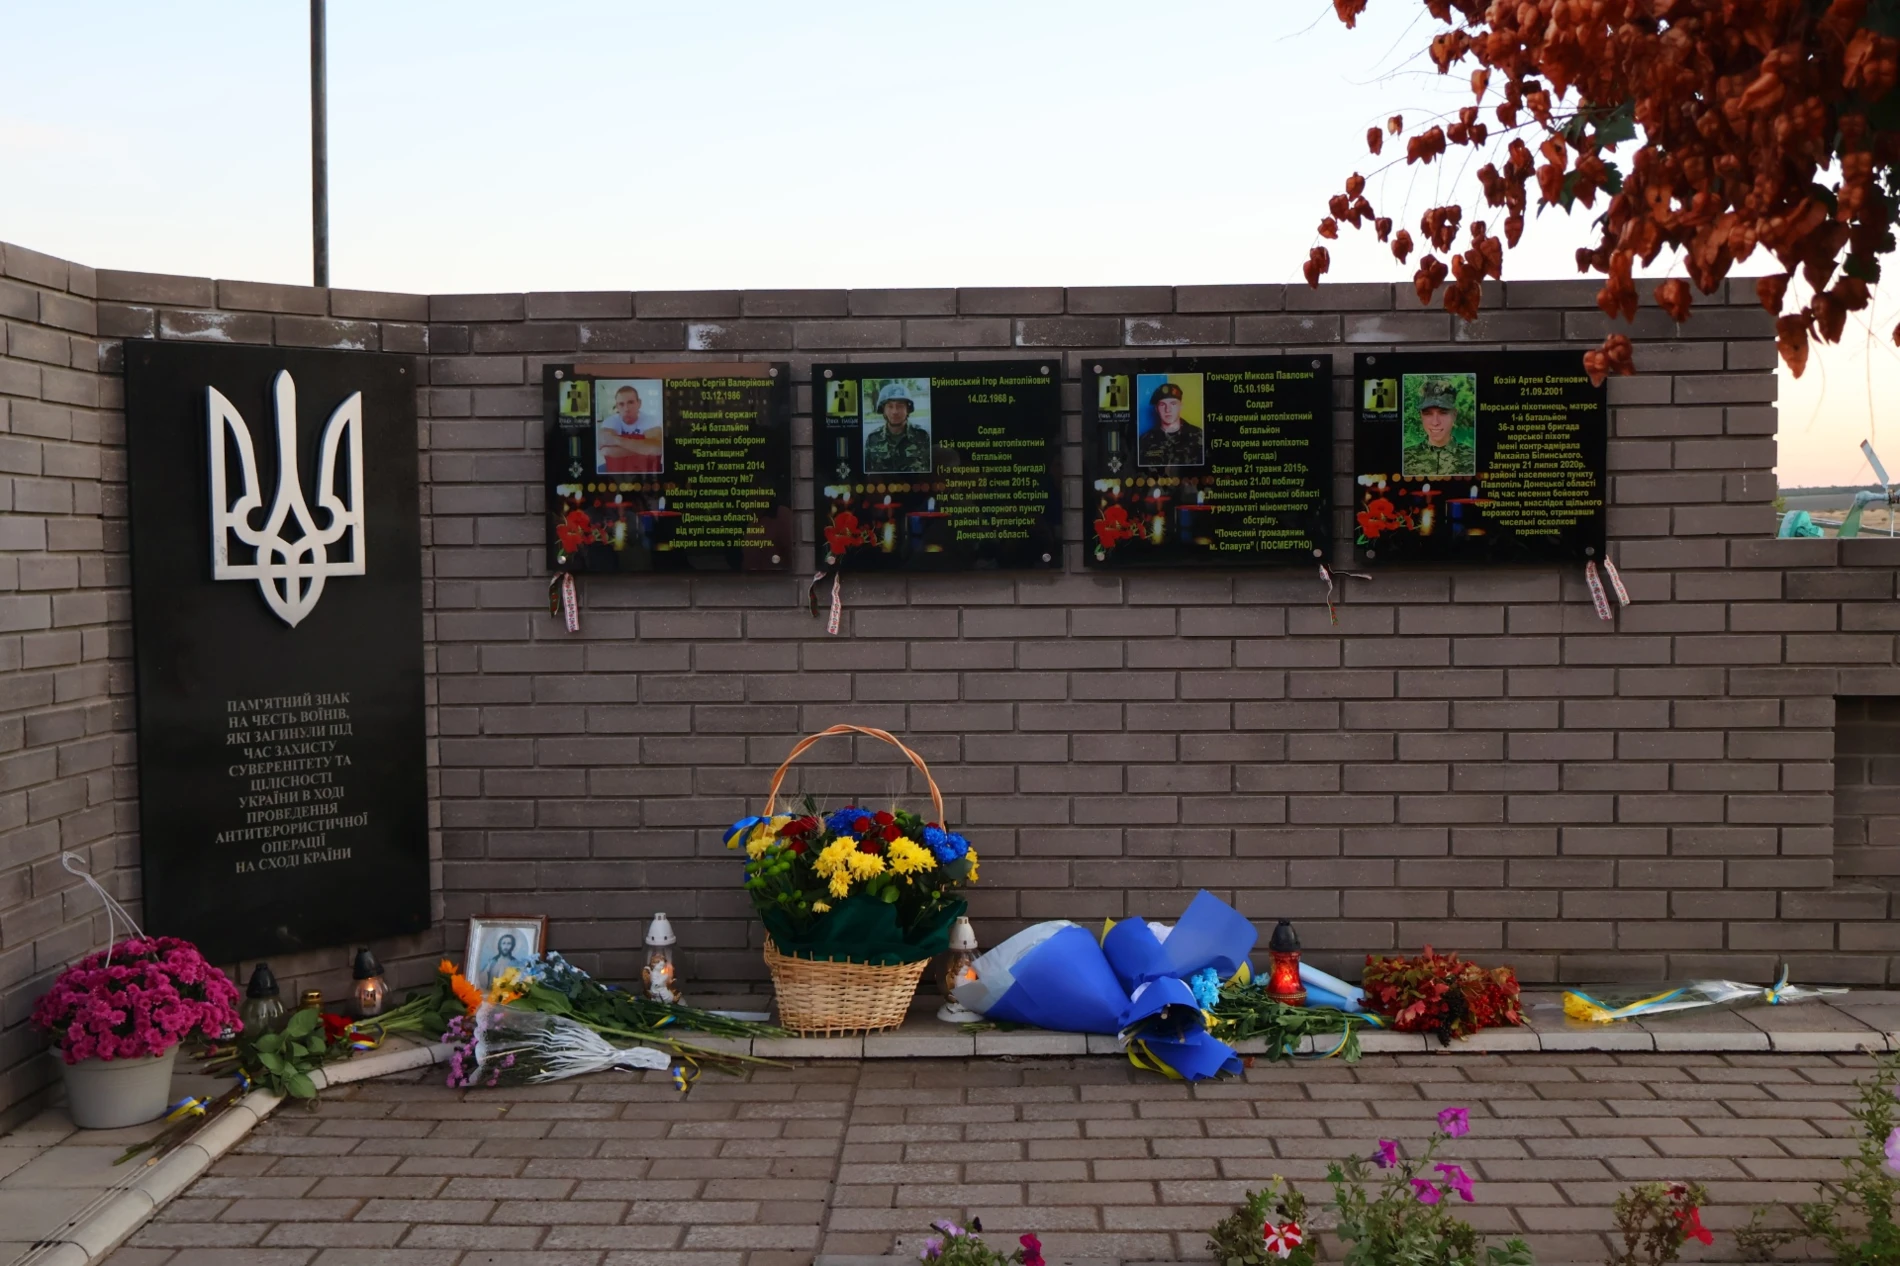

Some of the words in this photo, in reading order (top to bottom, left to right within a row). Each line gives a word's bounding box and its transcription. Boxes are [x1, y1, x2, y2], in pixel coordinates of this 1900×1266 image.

[1207, 372, 1242, 382] Гончарук
[1245, 372, 1274, 380] Микола
[1276, 370, 1314, 379] Павлович
[1494, 376, 1516, 385] Козій
[1518, 375, 1543, 385] Артем
[1545, 375, 1588, 384] Євгенович
[666, 379, 700, 389] Горобець
[702, 378, 726, 388] Сергій
[728, 378, 774, 388] Валерійович
[932, 377, 980, 388] Буйновський
[983, 377, 997, 387] Ігор
[999, 376, 1050, 385] Анатолійович
[1233, 384, 1275, 393] 05.10.1984
[1520, 387, 1563, 396] 21.09.2001
[1246, 400, 1273, 409] Солдат
[1480, 402, 1519, 412] Морський
[1522, 402, 1567, 411] піхотинець,
[1570, 402, 1598, 411] матрос
[682, 411, 722, 420] Молодший
[725, 411, 758, 420] сержант
[1207, 413, 1223, 421] 17-й
[1225, 413, 1258, 423] окремий
[1261, 411, 1312, 421] мотопіхотний
[1525, 413, 1567, 421] батальйон
[691, 423, 707, 431] 34-й
[709, 423, 749, 431] батальйон
[978, 426, 1006, 436] Солдат
[1240, 425, 1280, 434] батальйон
[1498, 423, 1514, 431] 36-а
[1517, 424, 1545, 432] окрема
[1548, 423, 1580, 432] бригада
[675, 437, 731, 447] територіальної
[733, 436, 765, 445] оборони
[1508, 432, 1543, 442] морської
[939, 439, 955, 448] 13-й
[957, 439, 990, 449] окремий
[993, 438, 1045, 447] мотопіхотний
[1211, 439, 1229, 450] (57-а
[1232, 439, 1260, 450] окрема
[1262, 438, 1309, 448] мотопіхотна
[1520, 442, 1580, 451] контр-адмірала
[972, 453, 1012, 461] батальйон
[1243, 451, 1277, 462] бригада)
[1494, 451, 1529, 460] Михайла
[1532, 451, 1583, 459] Білинського.
[674, 462, 704, 472] Загинув
[706, 462, 715, 470] 17
[717, 462, 745, 470] жовтня
[747, 461, 765, 469] 2014
[937, 465, 950, 475] (1-а
[953, 466, 980, 474] окрема
[1013, 464, 1045, 474] бригада)
[1212, 465, 1242, 475] Загинув
[1245, 465, 1253, 473] 21
[1255, 465, 1281, 474] травня
[1284, 463, 1308, 473] 2015р.
[1489, 462, 1521, 471] Загинув
[1522, 461, 1532, 469] 21
[1560, 461, 1586, 470] 2020р.
[699, 475, 738, 484] блокпосту
[1490, 471, 1516, 480] районі
[1519, 471, 1565, 479] населеного
[1567, 471, 1593, 480] пункту
[945, 479, 976, 489] Загинув
[978, 478, 987, 486] 28
[1012, 477, 1030, 486] 2015
[1216, 478, 1248, 486] близько
[1250, 477, 1270, 485] 21.00
[1272, 477, 1305, 487] поблизу
[1481, 480, 1522, 489] Павлопіль
[1524, 480, 1565, 489] Донецької
[1566, 479, 1595, 487] області
[666, 488, 697, 498] поблизу
[731, 487, 776, 497] Озерянівка,
[937, 492, 948, 501] під
[1013, 490, 1048, 501] обстрілів
[1249, 490, 1289, 500] Донецької
[1291, 489, 1319, 498] області
[1488, 490, 1499, 498] під
[686, 500, 724, 509] неподалік
[736, 500, 769, 509] Горлівка
[1524, 498, 1563, 507] внаслідок
[1565, 498, 1602, 506] щільного
[940, 506, 980, 514] взводного
[982, 506, 1017, 515] опорного
[1019, 505, 1045, 514] пункту
[1217, 503, 1258, 514] результаті
[1260, 502, 1308, 511] мінометного
[1482, 509, 1519, 517] ворожого
[1522, 509, 1548, 517] вогню,
[1551, 509, 1594, 517] отримавши
[682, 513, 721, 523] (Донецька
[723, 513, 758, 523] область),
[954, 518, 979, 528] районі
[991, 517, 1035, 528] Вуглегірськ
[1243, 516, 1278, 525] обстрілу.
[1500, 518, 1535, 526] чисельні
[1537, 517, 1576, 525] осколкові
[676, 526, 687, 535] від
[689, 526, 704, 536] кулі
[706, 526, 744, 536] снайпера,
[747, 526, 765, 534] який
[956, 530, 996, 541] Донецької
[998, 530, 1029, 539] області.
[1259, 529, 1304, 539] громадянин
[1516, 528, 1560, 536] поранення.
[669, 539, 698, 549] відкрив
[733, 539, 774, 548] лісосмуги.
[1261, 540, 1312, 550] ПОСМЕРТНО)
[316, 693, 350, 705] ЗНАК
[229, 716, 248, 728] НА
[252, 713, 296, 726] ЧЕСТЬ
[300, 709, 349, 722] ВОЇНІВ,
[227, 732, 250, 745] ЯКІ
[254, 726, 325, 742] ЗАГИНУЛИ
[330, 723, 353, 736] ПІД
[244, 746, 272, 759] ЧАС
[275, 741, 336, 756] ЗАХИСТУ
[229, 758, 332, 776] СУВЕРЕНІТЕТУ
[335, 755, 351, 766] ТА
[251, 772, 332, 791] ЦІЛІСНОСТІ
[239, 791, 298, 808] УКРАЇНИ
[303, 790, 310, 800] В
[314, 786, 344, 799] ХОДІ
[247, 803, 337, 823] ПРОВЕДЕННЯ
[215, 812, 368, 843] АНТИТЕРОРИСТИЧНОЇ
[261, 834, 326, 853] ОПЕРАЦІЇ
[236, 861, 255, 873] НА
[259, 855, 299, 870] СХОДІ
[303, 847, 351, 864] КРАЇНИ
